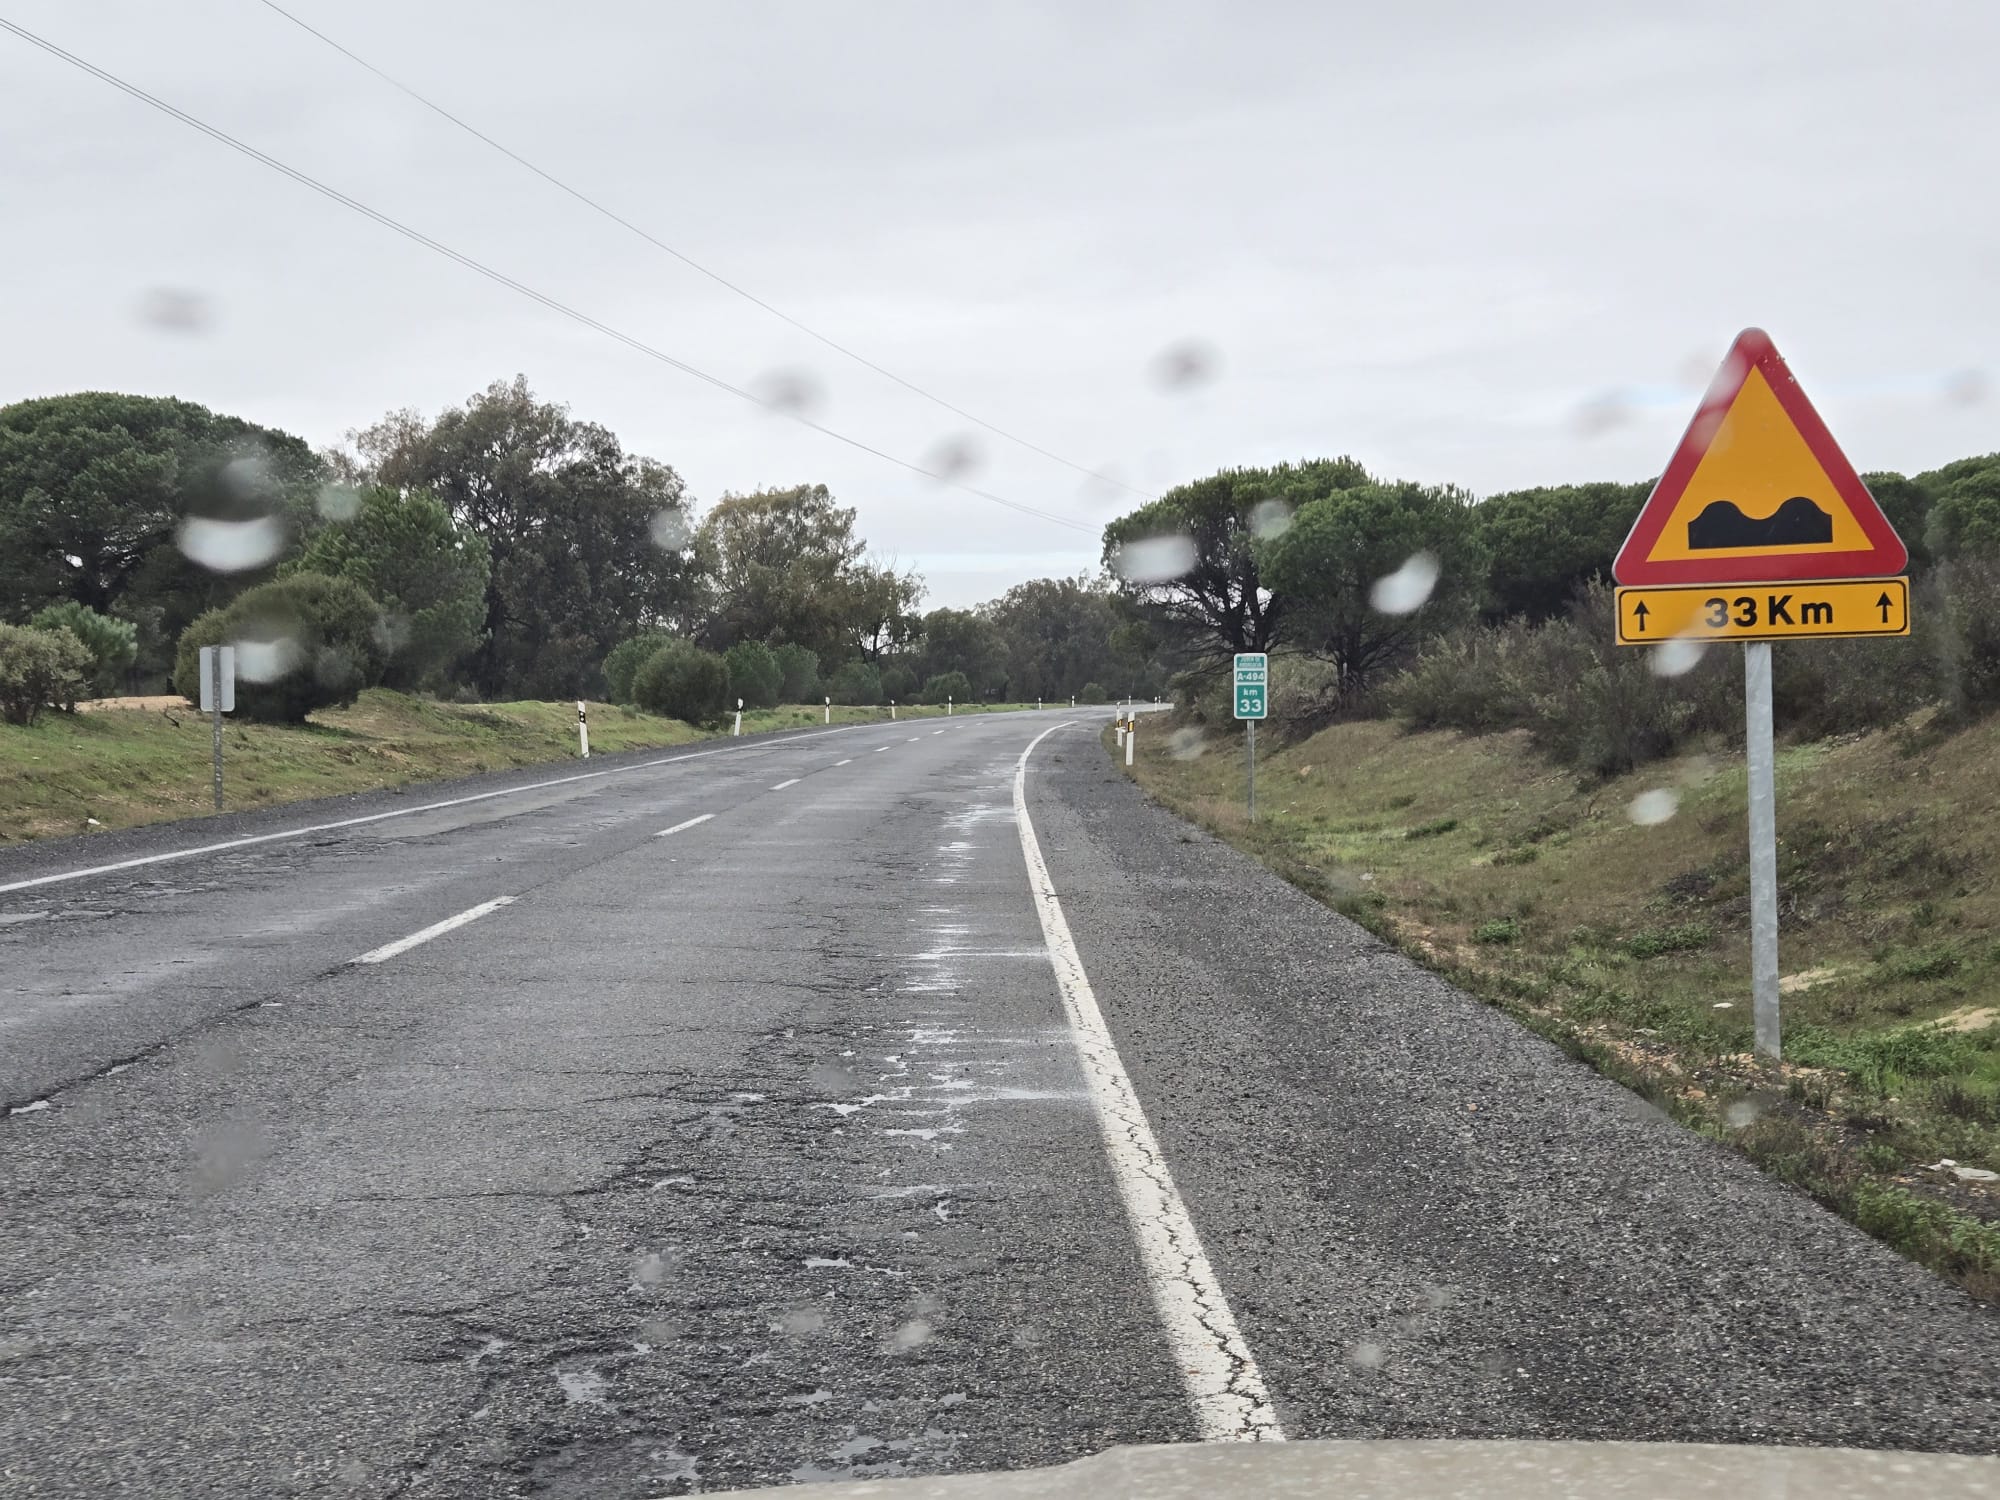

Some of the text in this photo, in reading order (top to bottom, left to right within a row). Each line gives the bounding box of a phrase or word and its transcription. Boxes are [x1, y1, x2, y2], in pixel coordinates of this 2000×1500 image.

[1237, 672, 1265, 681] A-494
[1243, 687, 1258, 696] km
[1240, 699, 1262, 713] 33
